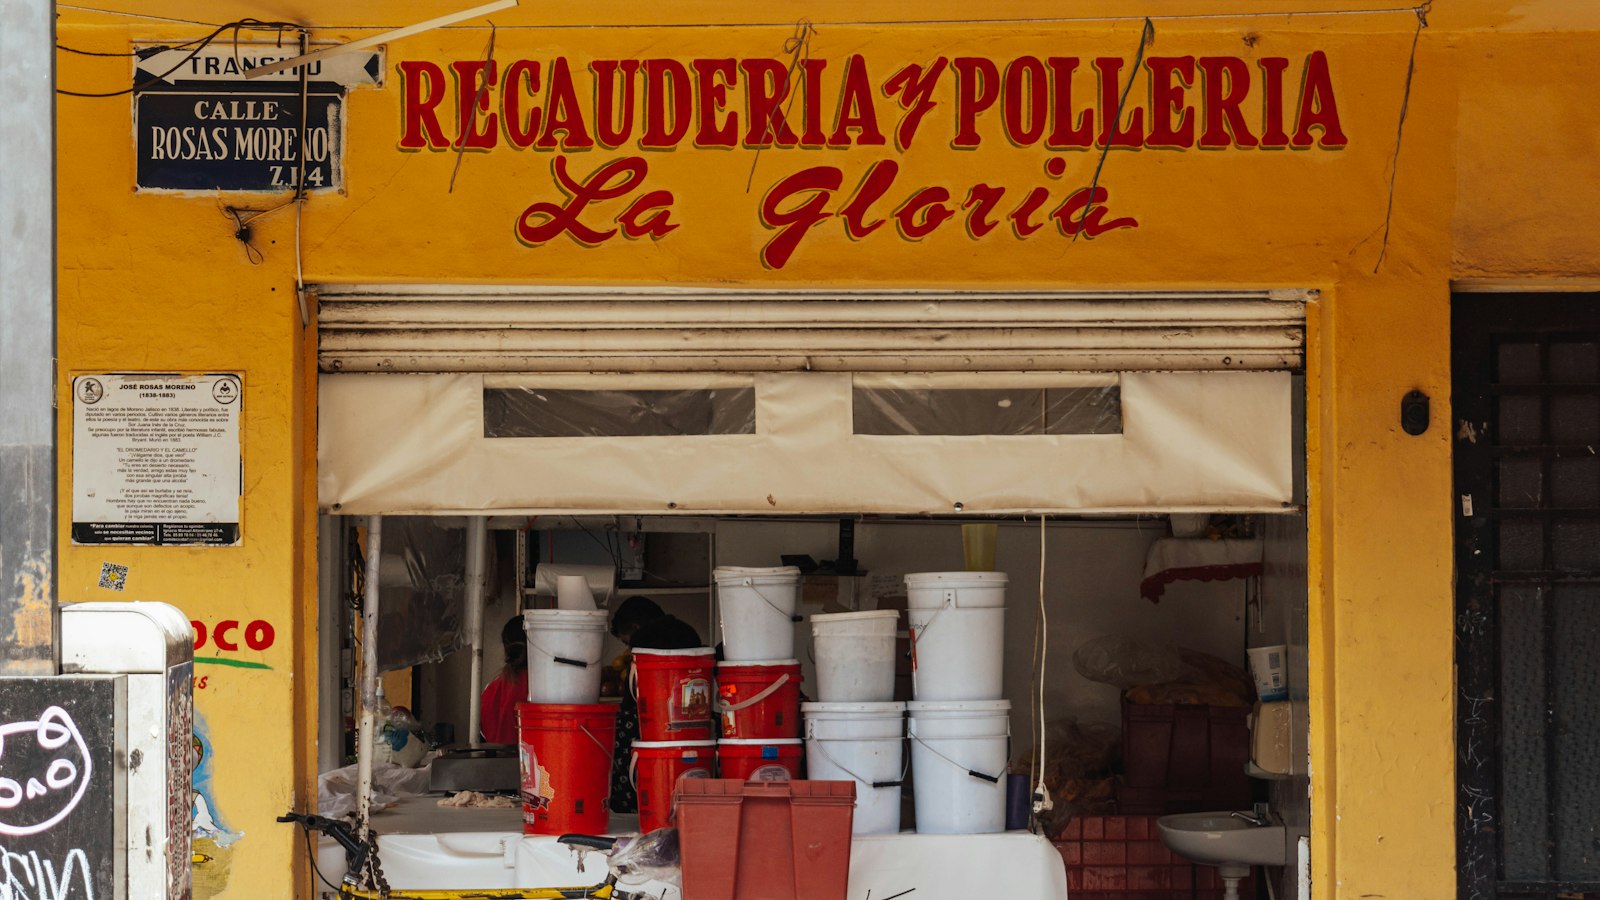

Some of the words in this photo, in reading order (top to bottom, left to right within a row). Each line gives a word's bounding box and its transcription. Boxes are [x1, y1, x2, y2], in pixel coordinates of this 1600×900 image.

[194, 100, 279, 121] CALLE
[397, 54, 886, 152] RECAUDERIA
[950, 50, 1348, 152] POLLERIA
[151, 126, 228, 161] ROSAS
[234, 126, 328, 162] MORENO
[514, 155, 681, 249] La
